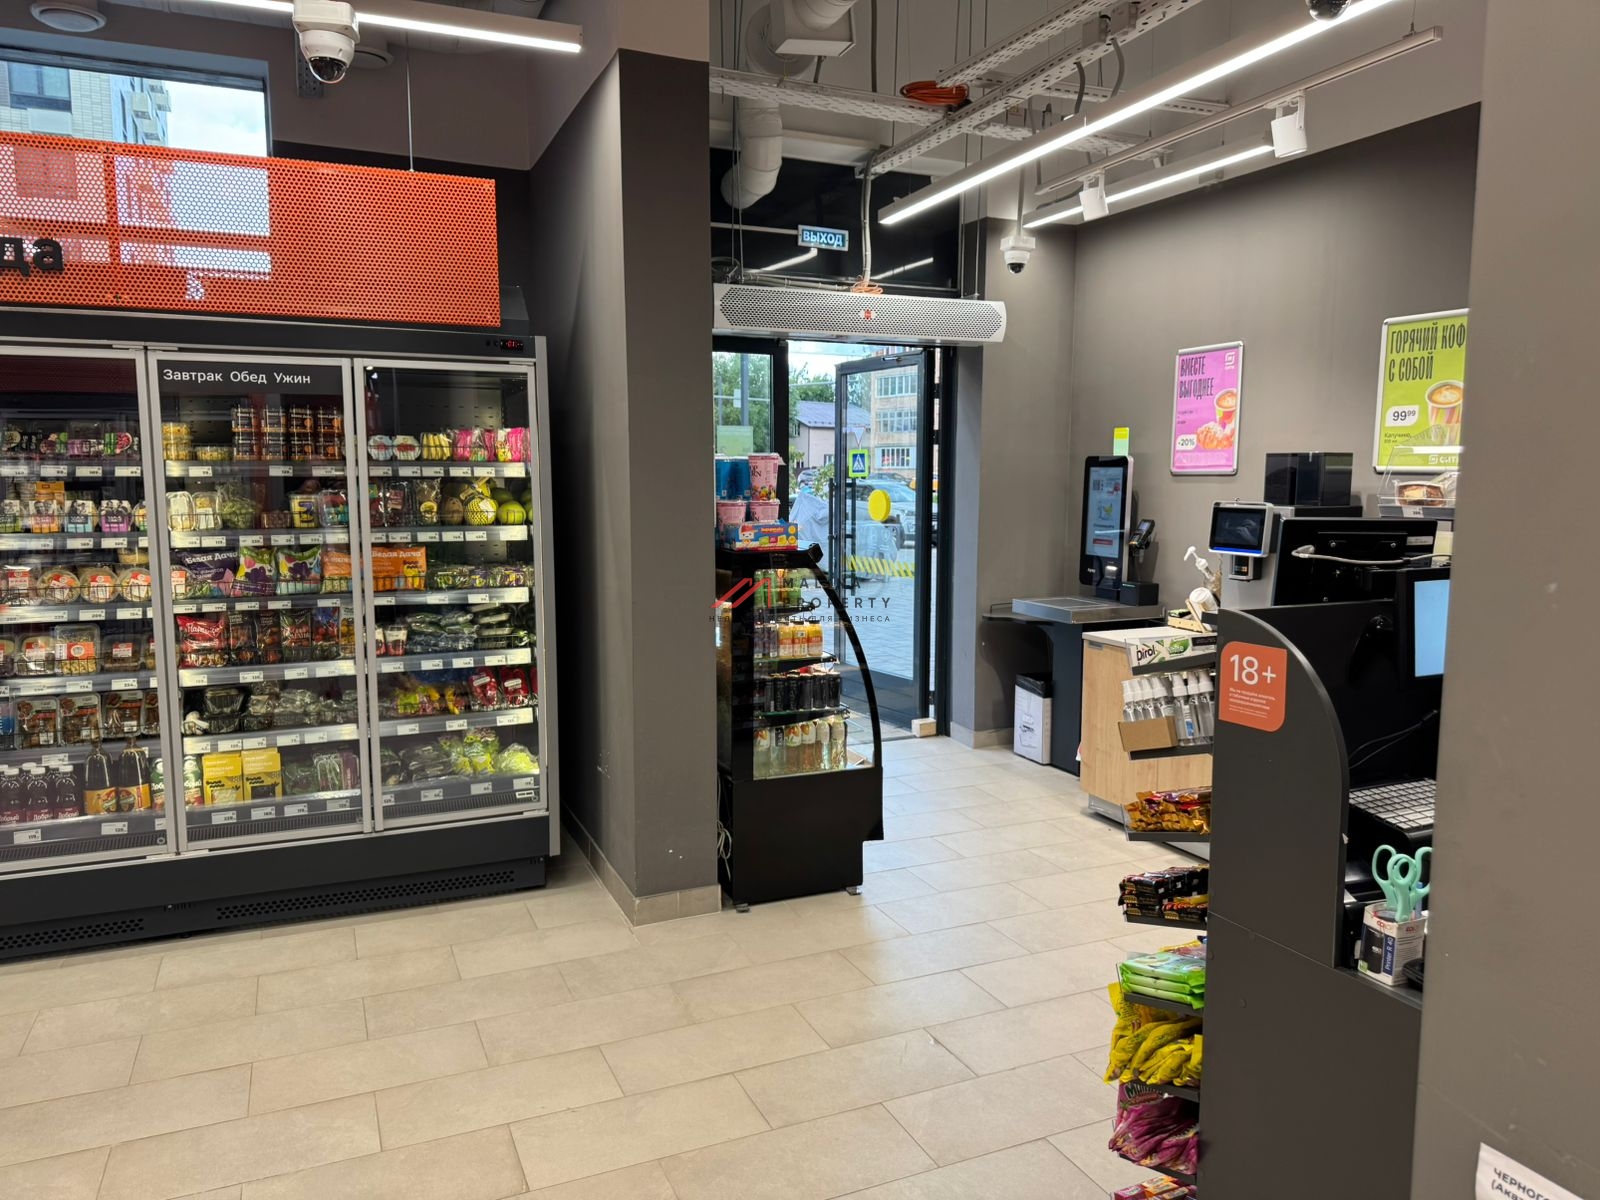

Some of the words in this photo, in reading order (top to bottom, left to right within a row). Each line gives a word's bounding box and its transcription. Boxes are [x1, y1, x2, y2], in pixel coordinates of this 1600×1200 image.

[803, 230, 843, 247] ВЫХОД
[1390, 321, 1438, 354] ГОРЯЧИЙ
[1441, 323, 1466, 350] КОФ
[163, 369, 223, 383] Завтрак
[230, 371, 267, 384] Обед
[274, 372, 311, 384] Ужин
[1180, 356, 1206, 377] ВМЕСТЕ
[1388, 358, 1396, 382] С
[1398, 351, 1434, 381] СОБОЙ
[1179, 377, 1215, 400] ВЫГОДНЕЕ
[1136, 645, 1156, 662] Dirol
[1230, 654, 1277, 685] 18+
[1385, 951, 1393, 970] Printer
[1491, 1178, 1524, 1200] (Акв
[1493, 1167, 1551, 1200] ЧЕРНОГ
